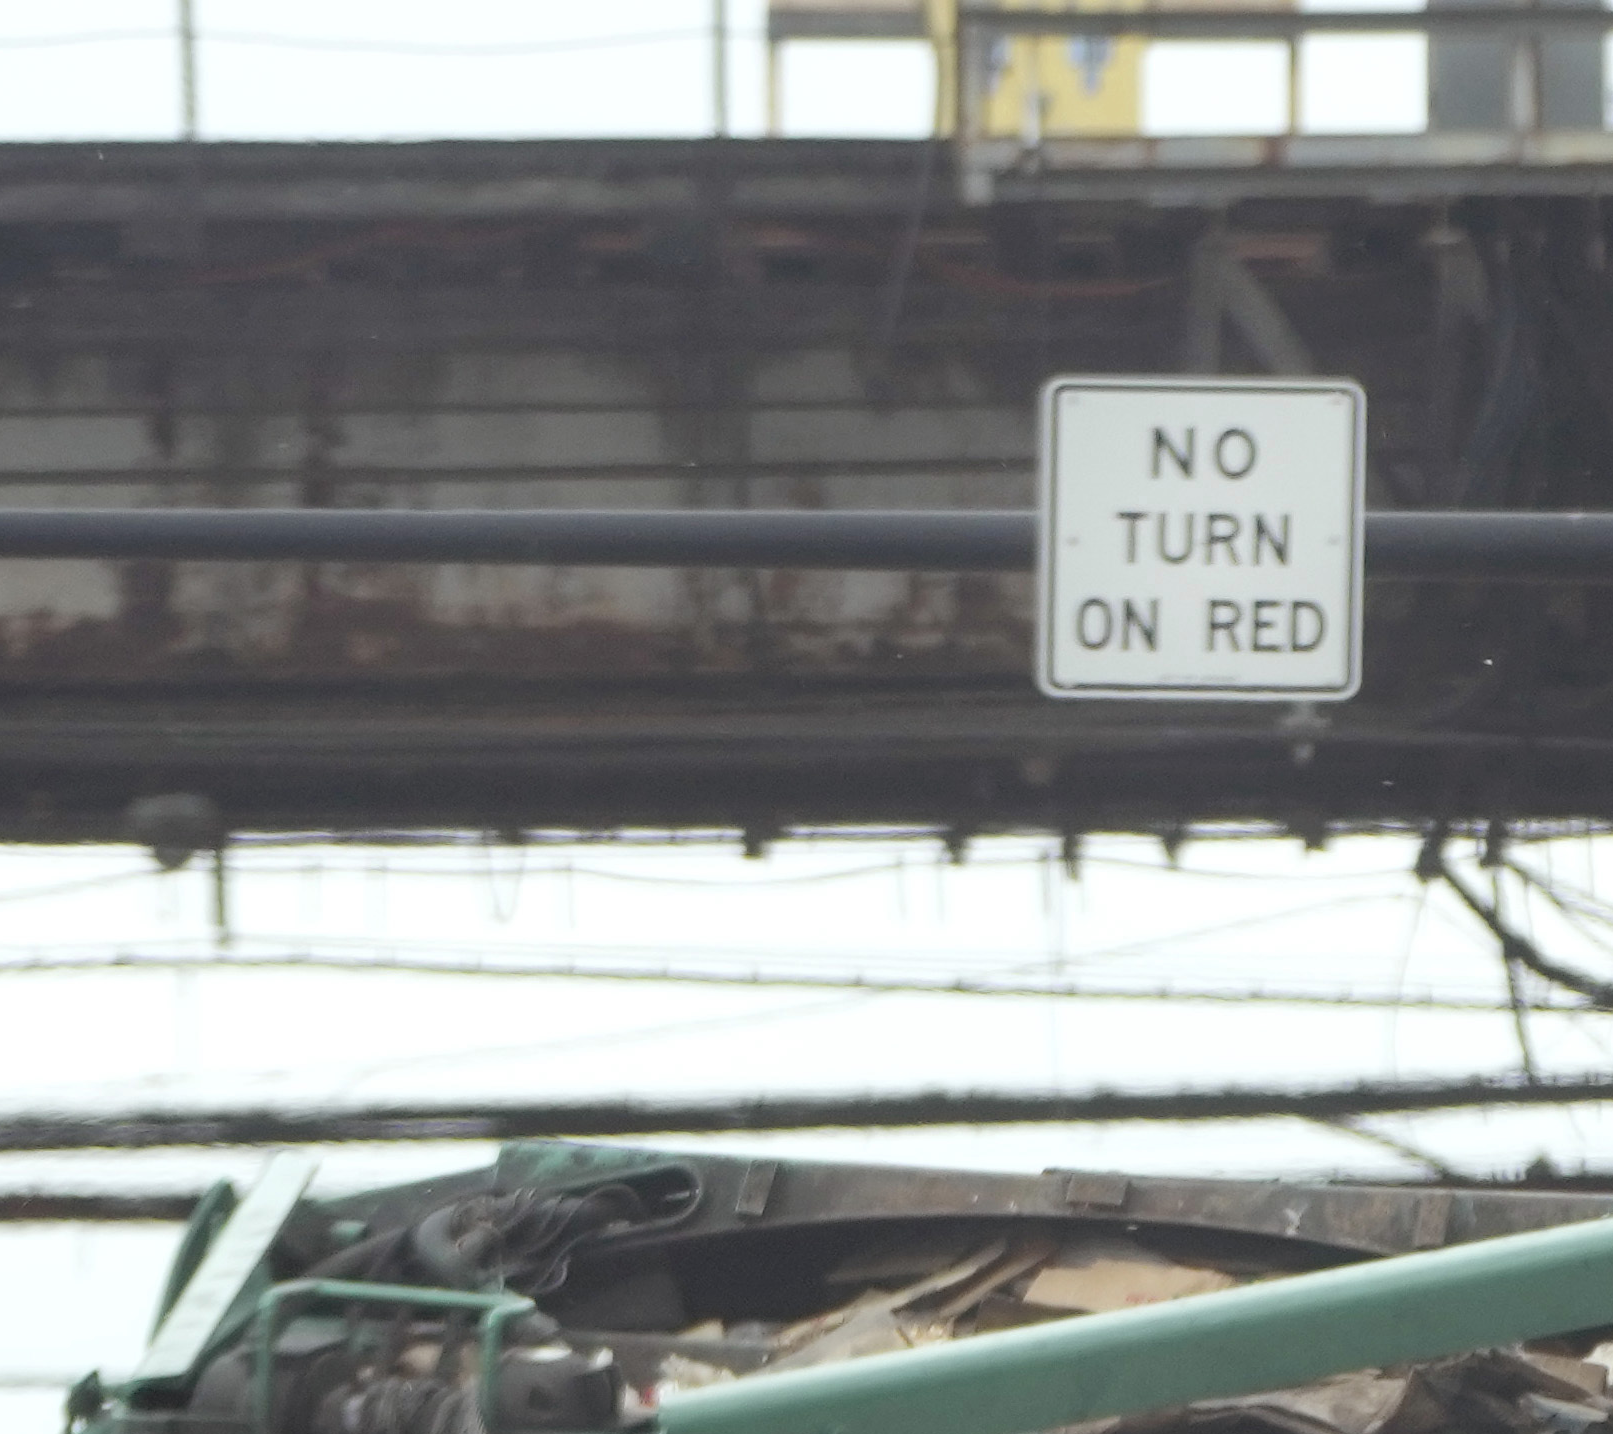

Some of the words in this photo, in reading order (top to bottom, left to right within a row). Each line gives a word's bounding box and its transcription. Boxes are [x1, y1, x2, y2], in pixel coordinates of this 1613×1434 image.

[1151, 426, 1257, 479] NO
[1115, 511, 1292, 565] TURN
[1077, 597, 1160, 651] ON
[1207, 598, 1328, 652] RED
